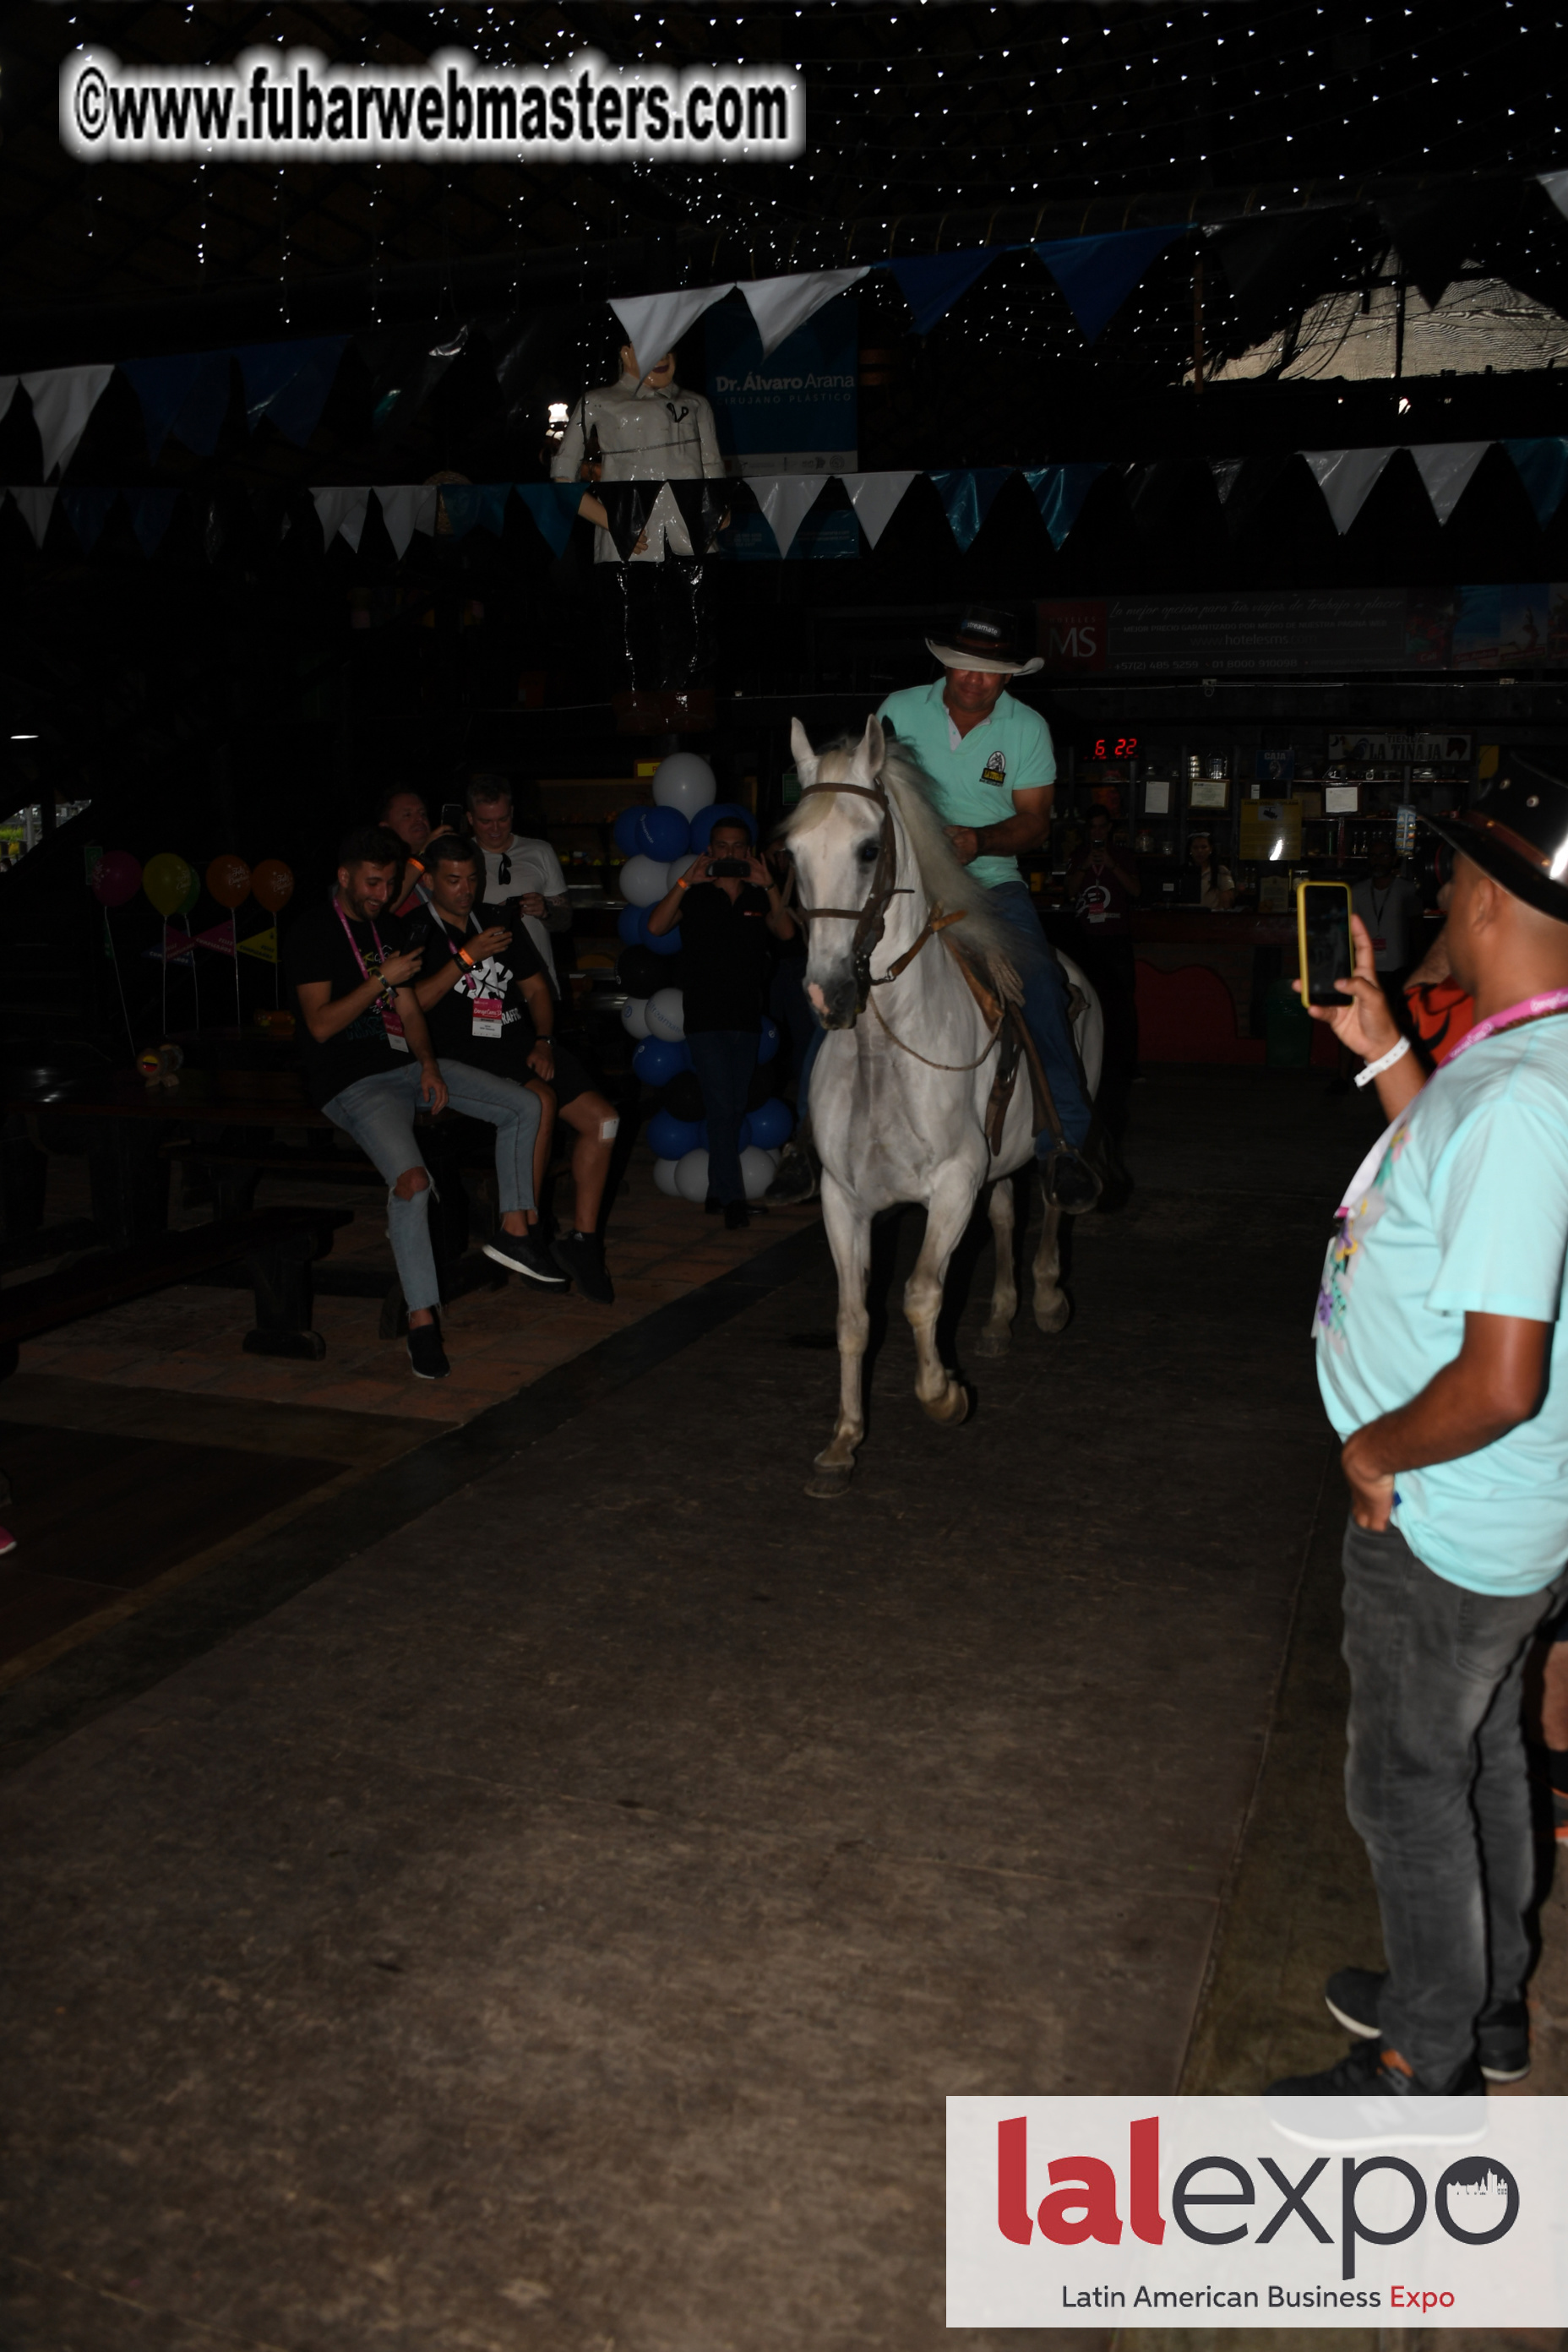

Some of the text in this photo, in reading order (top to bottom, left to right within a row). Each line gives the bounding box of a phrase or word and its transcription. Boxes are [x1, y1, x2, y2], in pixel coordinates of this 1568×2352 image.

[804, 373, 855, 389] Arana
[716, 393, 852, 406] CIRUJANO PLÁSTICO
[1109, 602, 1123, 618] La
[1126, 606, 1158, 621] mejor
[1198, 605, 1228, 619] para
[1252, 601, 1285, 618] viajes
[1288, 598, 1304, 611] de
[1307, 597, 1350, 617] trabajo
[1359, 596, 1403, 616] placer
[966, 621, 999, 635] streamate
[1048, 626, 1097, 658] MS
[1190, 633, 1318, 646] www.hotelesms.com
[1149, 661, 1170, 670] 485
[1173, 660, 1199, 669] 5259
[1211, 660, 1223, 668] 01
[1227, 659, 1255, 668] 8000
[1258, 658, 1298, 668] 910098
[1369, 743, 1441, 760] LA TINAJA
